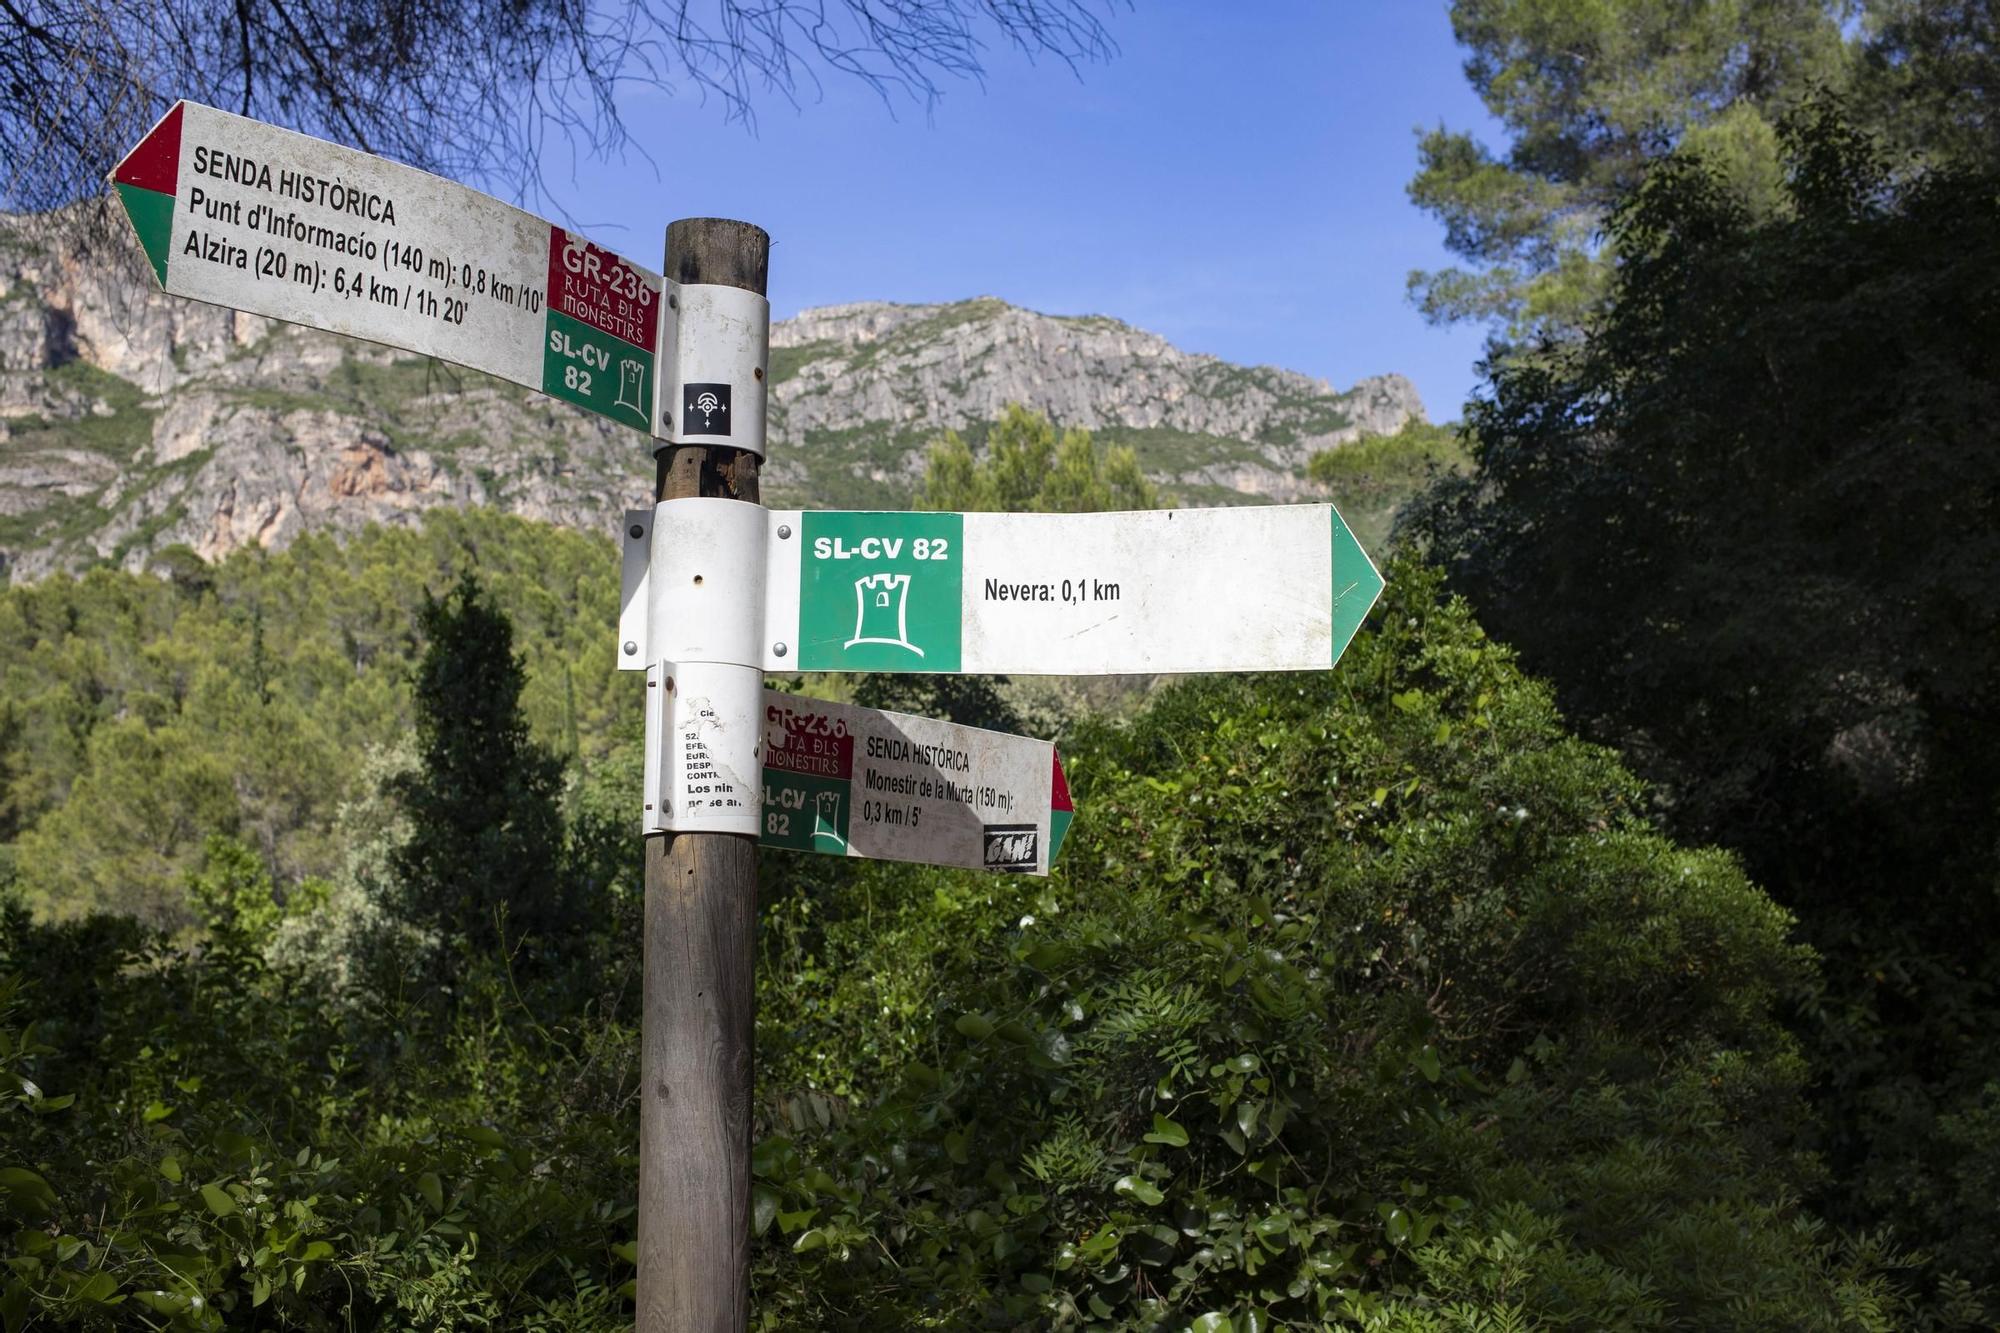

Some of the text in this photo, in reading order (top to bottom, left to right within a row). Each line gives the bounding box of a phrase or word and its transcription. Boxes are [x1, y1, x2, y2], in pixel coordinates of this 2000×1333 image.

[193, 146, 396, 226] SENDA HISTÒRICA
[189, 187, 241, 225] Punt
[383, 239, 423, 273] (140
[428, 256, 457, 289] m):
[462, 264, 486, 295] 0,8
[491, 273, 514, 305] km
[183, 230, 468, 325] Alzira (20 m): 6,4 km / 1h 20'
[562, 244, 651, 307] GR-236
[564, 274, 611, 310] RUTA
[563, 294, 643, 344] MONESTIRS
[550, 330, 610, 372] SL-CV
[564, 365, 592, 396] 82
[813, 537, 948, 560] SL-CV 82
[984, 578, 1121, 605] Nevera: 0,1 km
[867, 736, 970, 774] SENDA HISTÒRICA
[688, 784, 711, 794] Los
[865, 768, 1013, 814] Monestir de la Murta (150 m):
[767, 812, 790, 836] 82
[863, 800, 922, 827] 0,3 km / 5'
